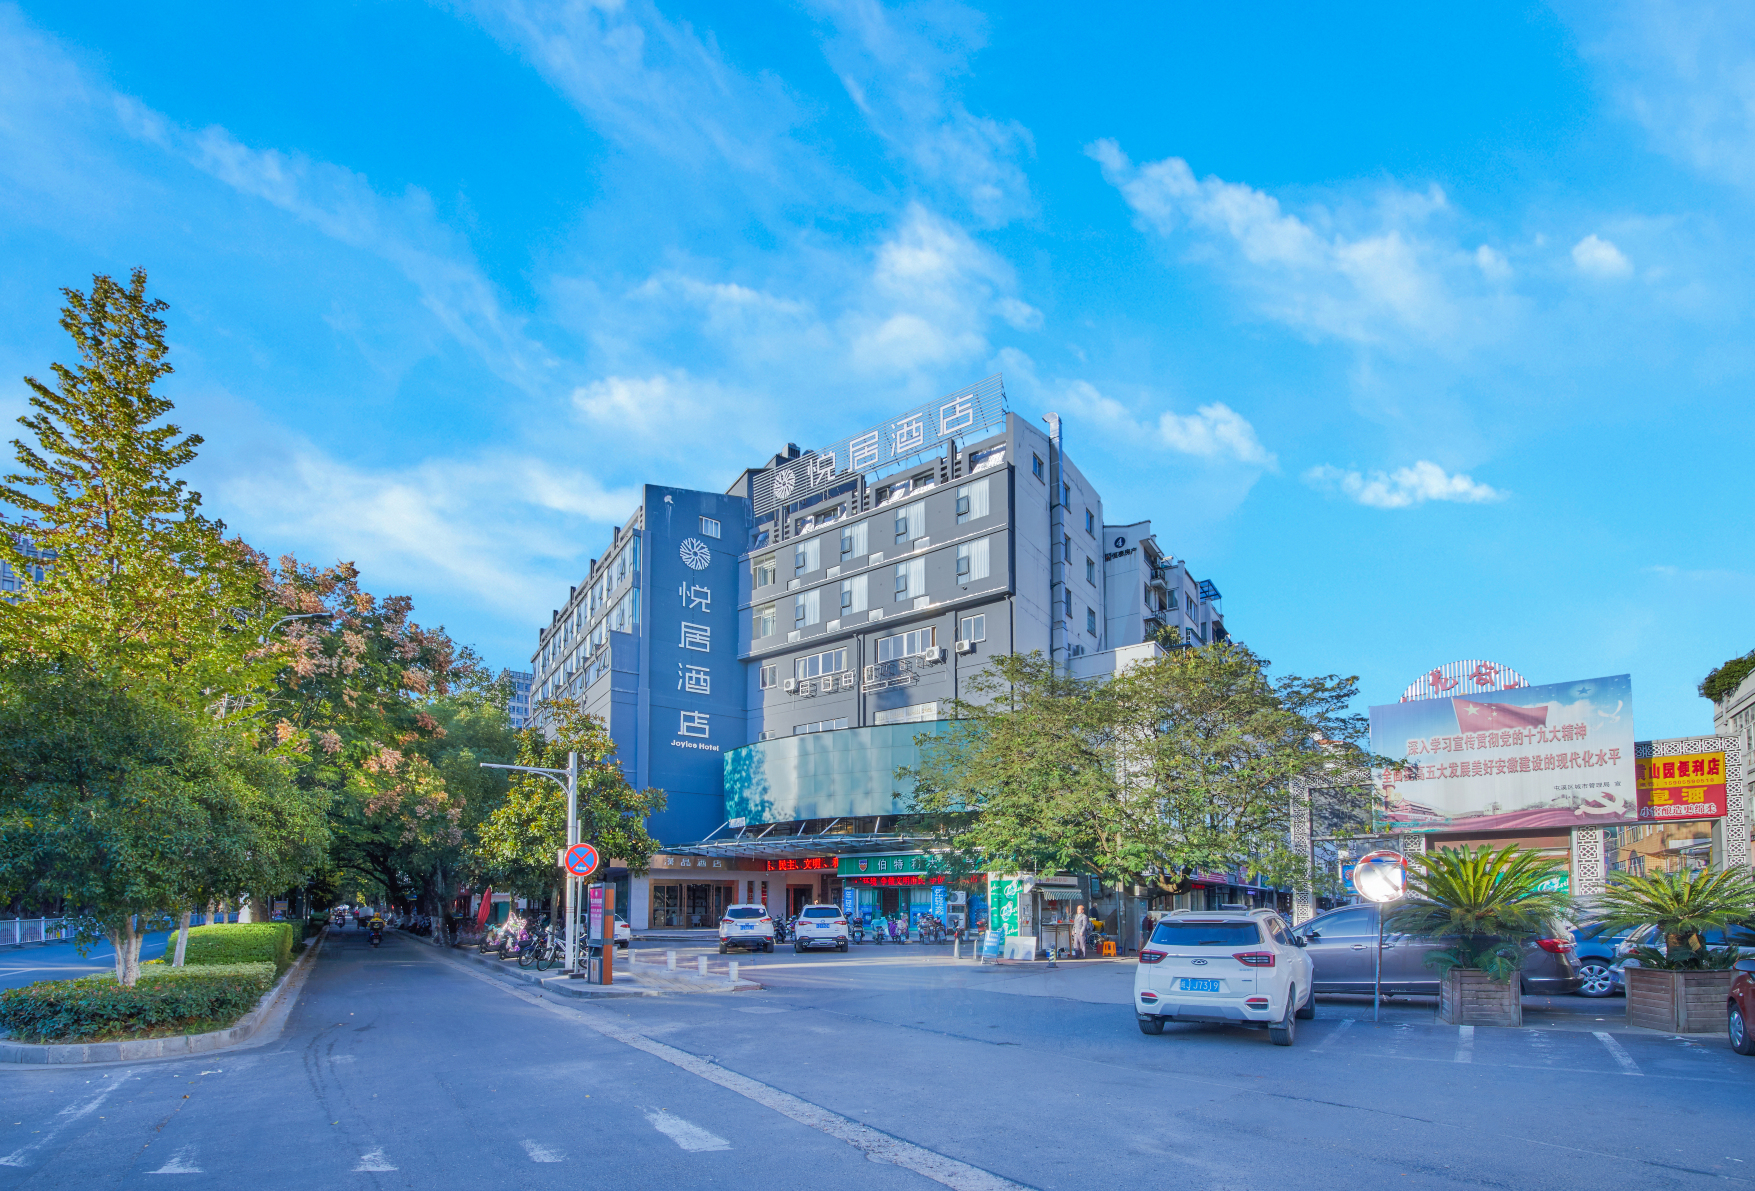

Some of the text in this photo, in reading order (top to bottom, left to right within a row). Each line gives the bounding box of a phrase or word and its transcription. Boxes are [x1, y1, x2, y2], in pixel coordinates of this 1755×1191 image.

[807, 394, 974, 488] 悦居酒店
[677, 581, 711, 738] 悦居酒店
[698, 743, 720, 752] Hotel
[1407, 722, 1587, 756] 深入学习宣传贯彻党的十九大精神
